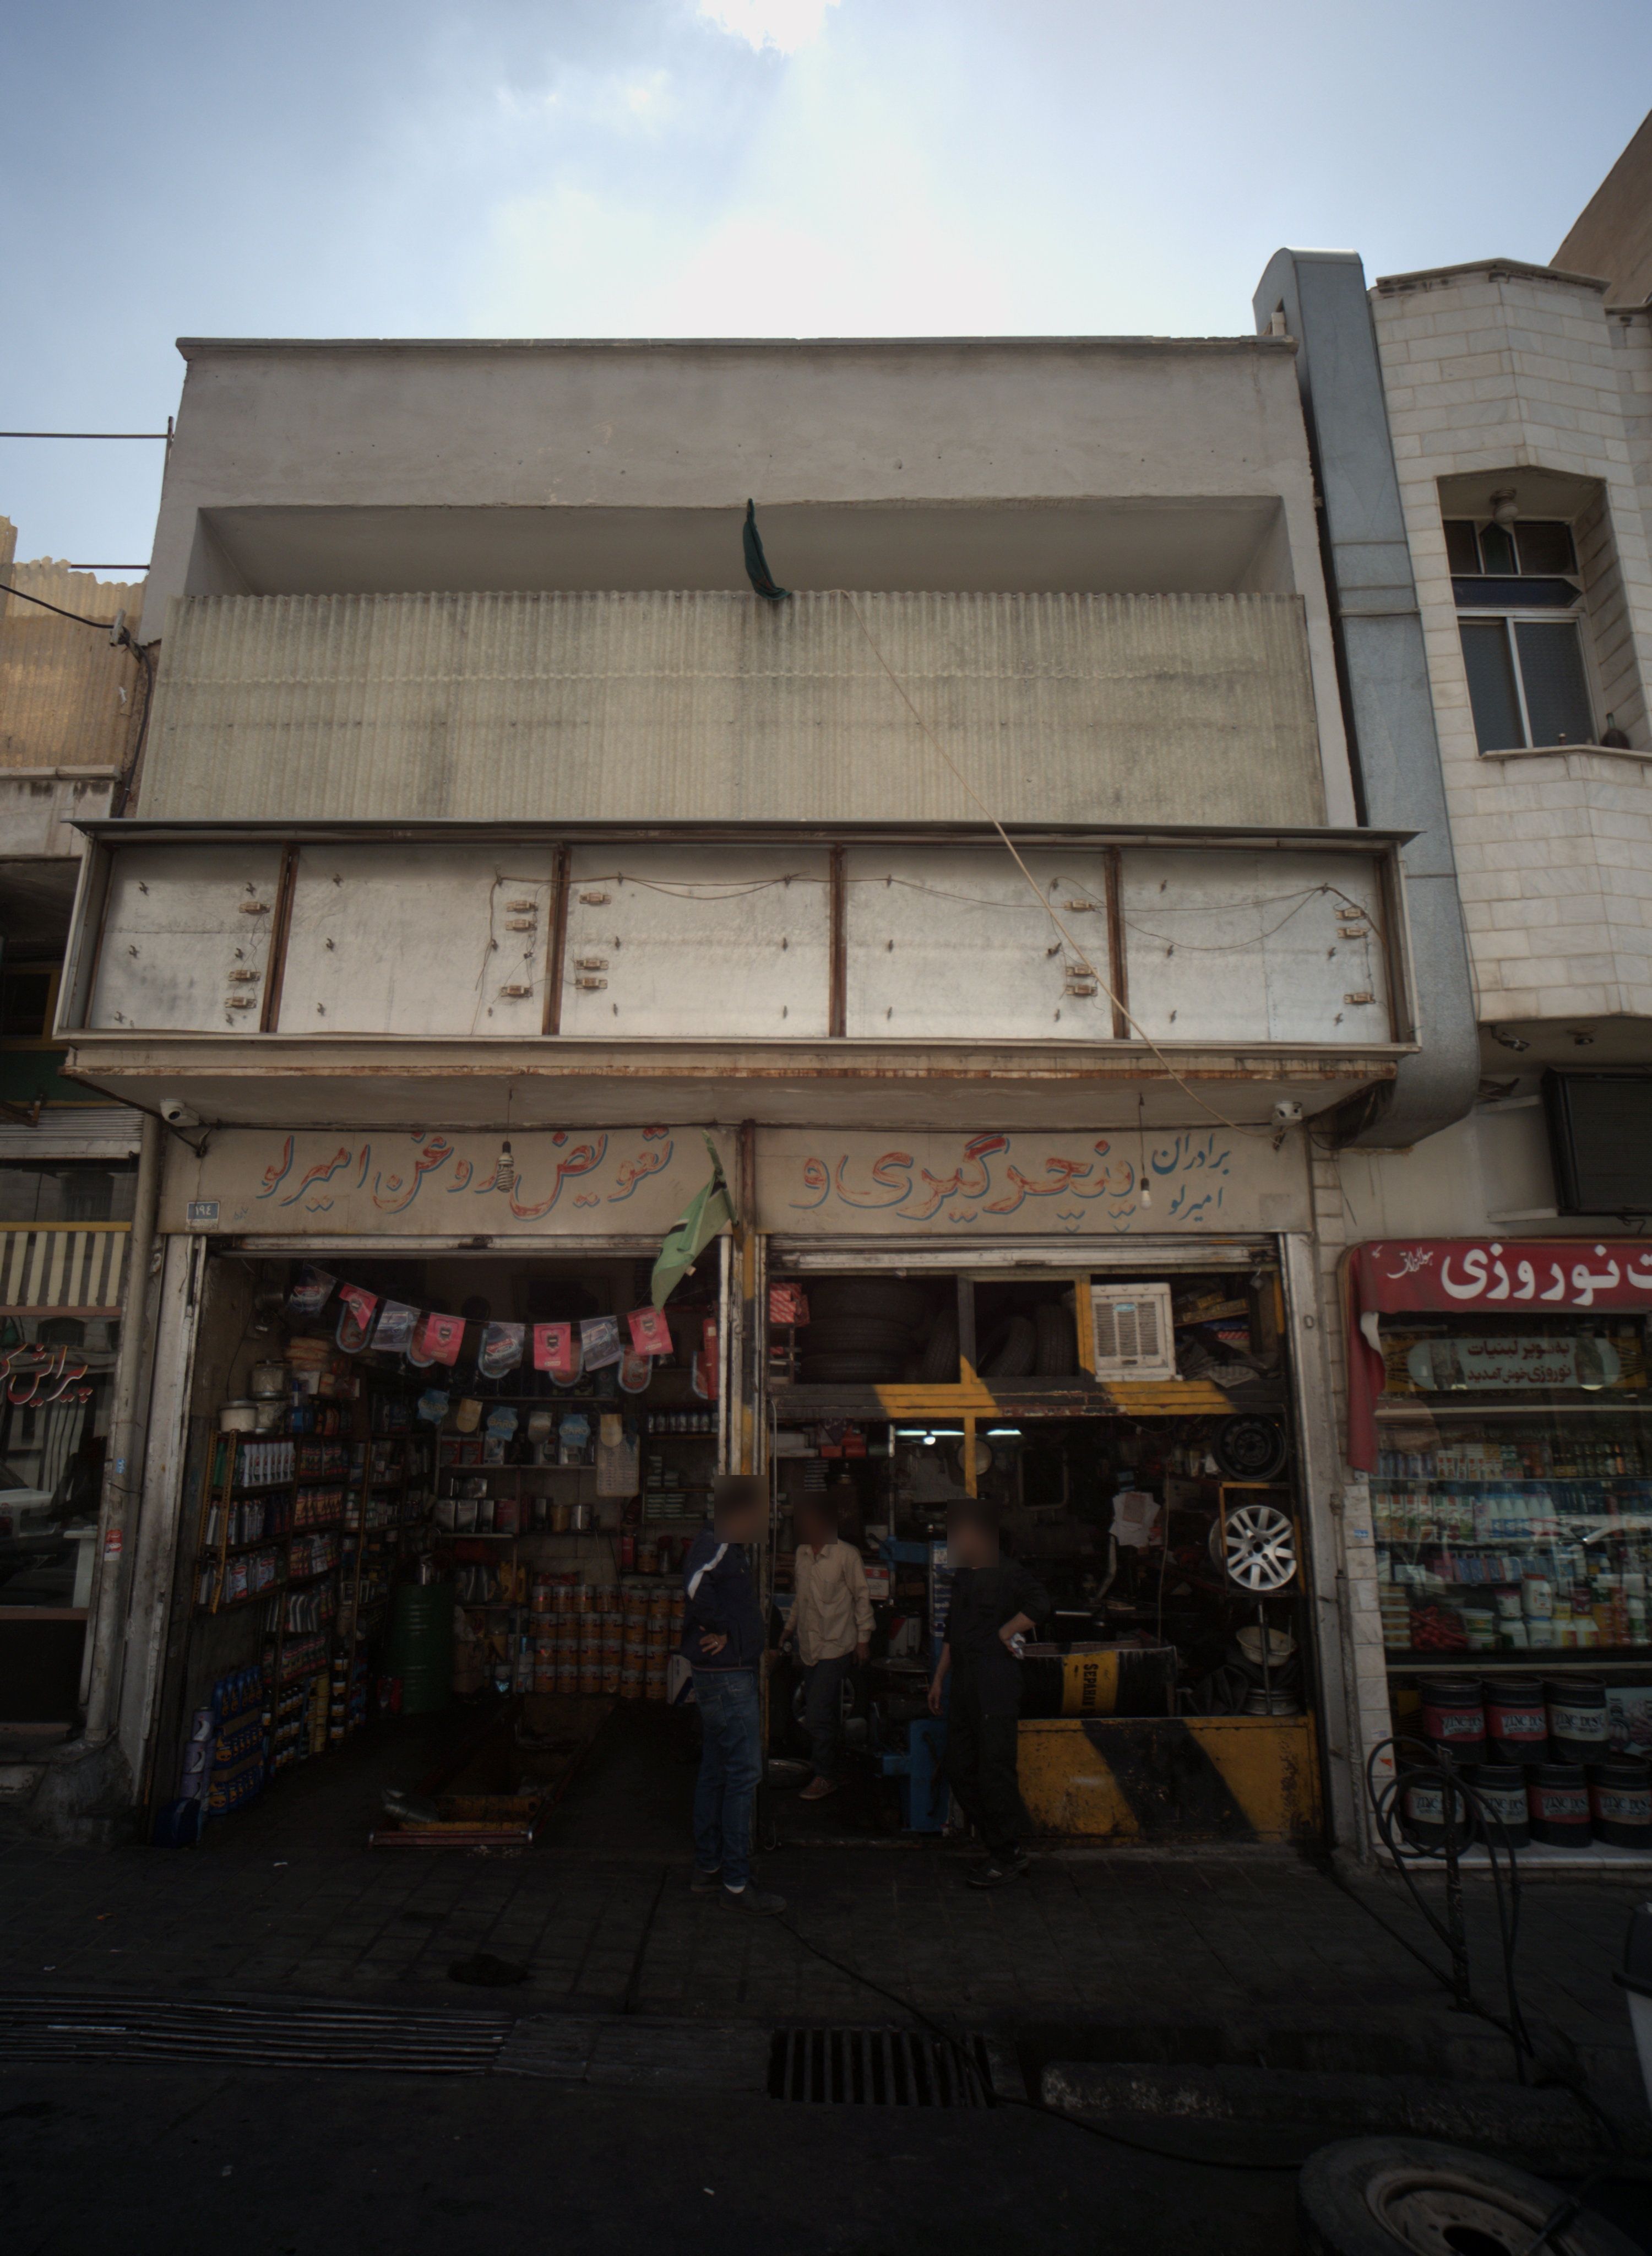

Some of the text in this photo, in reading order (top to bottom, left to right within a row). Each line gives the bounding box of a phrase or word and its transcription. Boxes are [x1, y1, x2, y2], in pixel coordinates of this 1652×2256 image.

[256, 1127, 674, 1222] تعویض روغن امیرلو
[1151, 1132, 1231, 1175] برادران
[789, 1156, 831, 1209] و
[1169, 1186, 1224, 1222] امیرلو
[1441, 1242, 1621, 1306] نوروزی
[1468, 1340, 1518, 1359] لبنیات
[7, 1342, 93, 1407] پیرایش
[1467, 1366, 1571, 1384] نوروزی خوش آمدید
